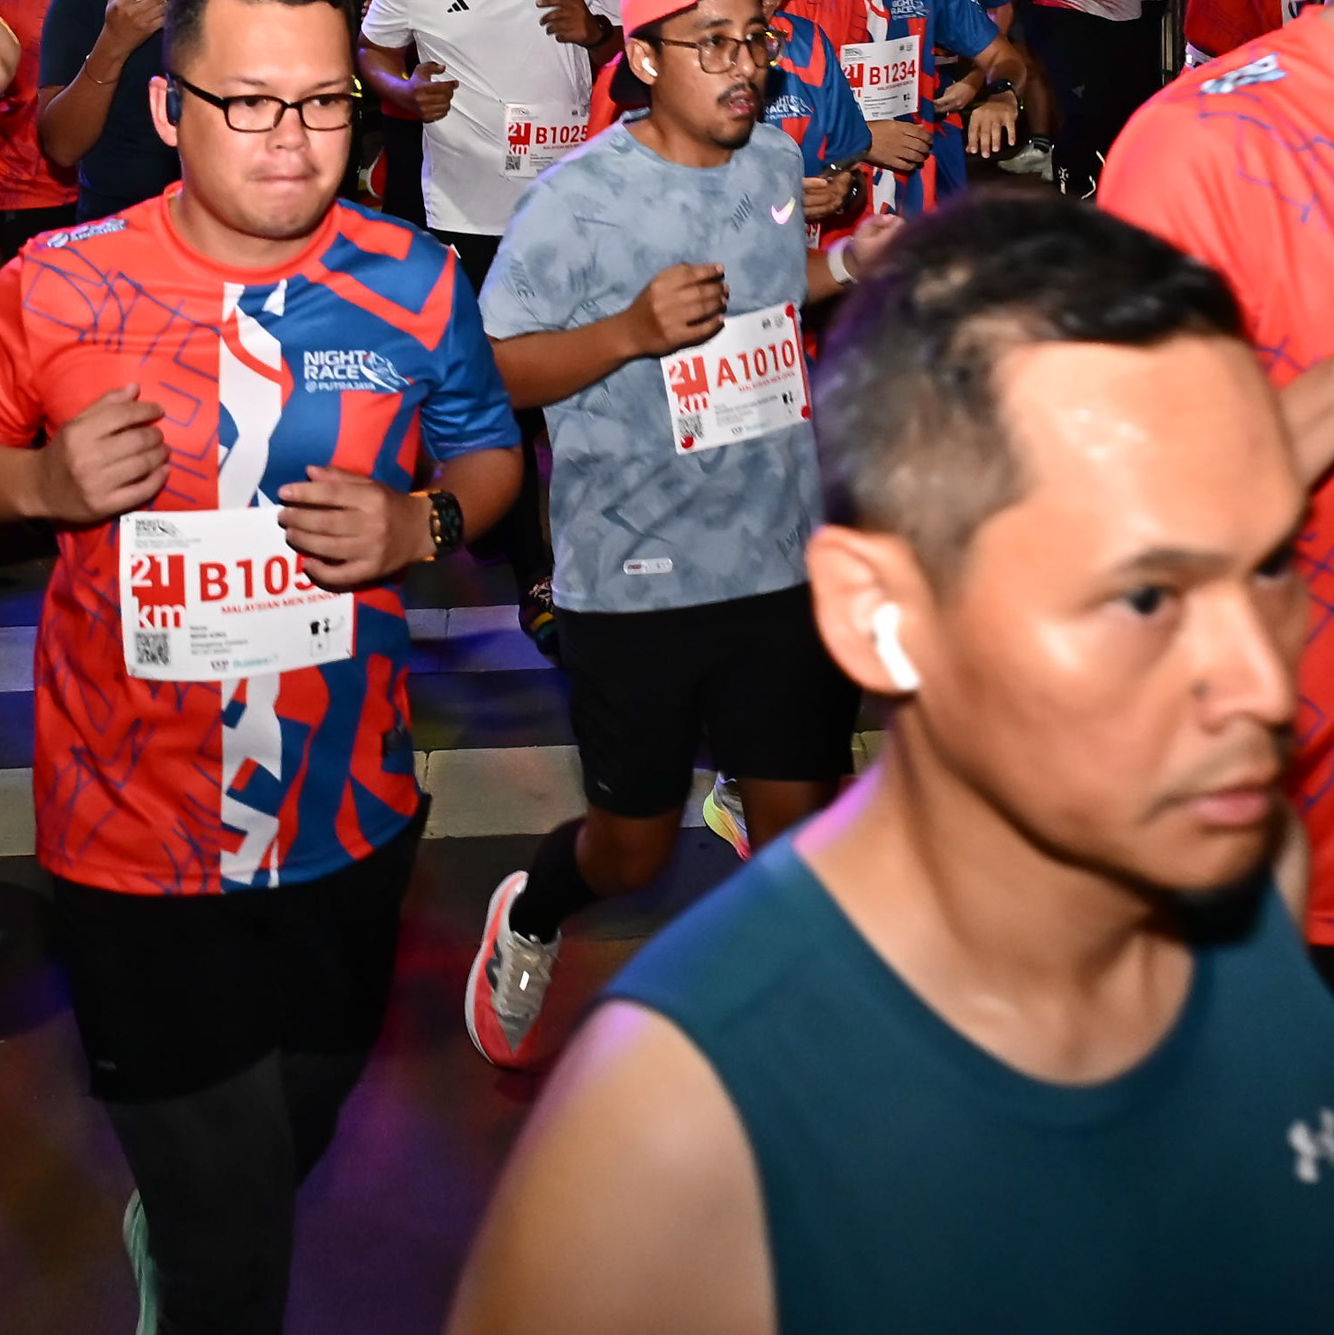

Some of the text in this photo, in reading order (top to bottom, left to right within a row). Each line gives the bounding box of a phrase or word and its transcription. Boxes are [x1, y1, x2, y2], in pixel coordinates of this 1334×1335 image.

[869, 59, 916, 85] B1234
[508, 123, 588, 144] 21 B1025
[304, 350, 367, 365] NIGHT
[670, 339, 796, 388] 21 A1010
[304, 364, 360, 380] RACE
[676, 391, 710, 414] km
[132, 554, 315, 602] 21 B105
[138, 603, 186, 628] km
[222, 601, 280, 614] MALAYSIAN
[282, 597, 304, 608] MEN
